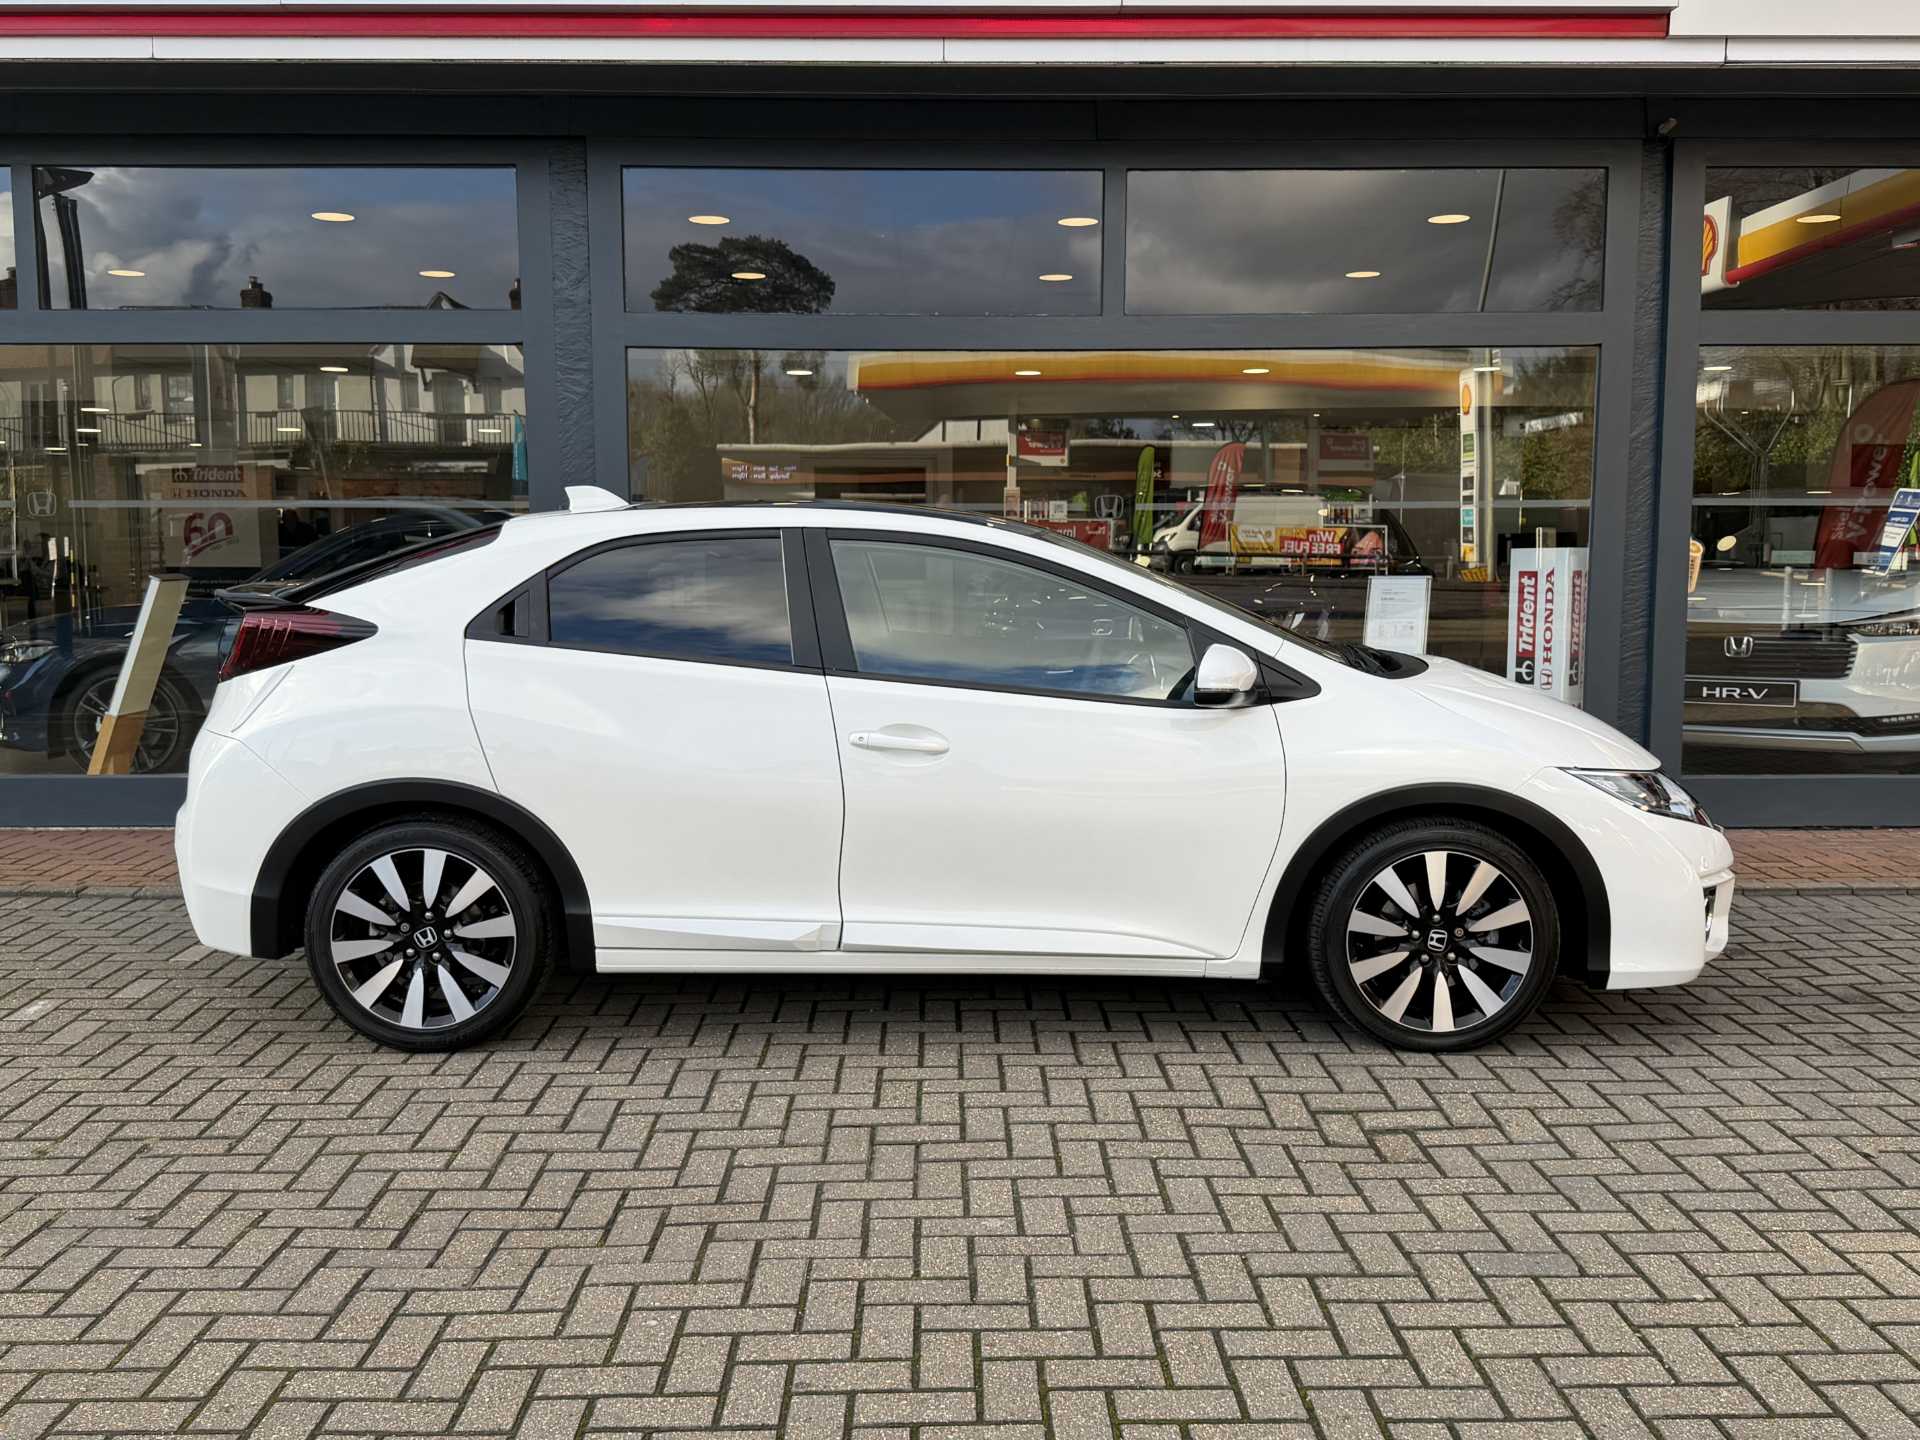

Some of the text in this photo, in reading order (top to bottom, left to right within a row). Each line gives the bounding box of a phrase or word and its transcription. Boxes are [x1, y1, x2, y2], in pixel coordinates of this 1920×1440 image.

[187, 487, 248, 498] HONDA
[193, 467, 241, 481] Trident
[1518, 575, 1536, 653] Trident
[1542, 567, 1555, 666] HONDA
[1572, 573, 1582, 654] Trident
[1702, 686, 1769, 700] HR-V
